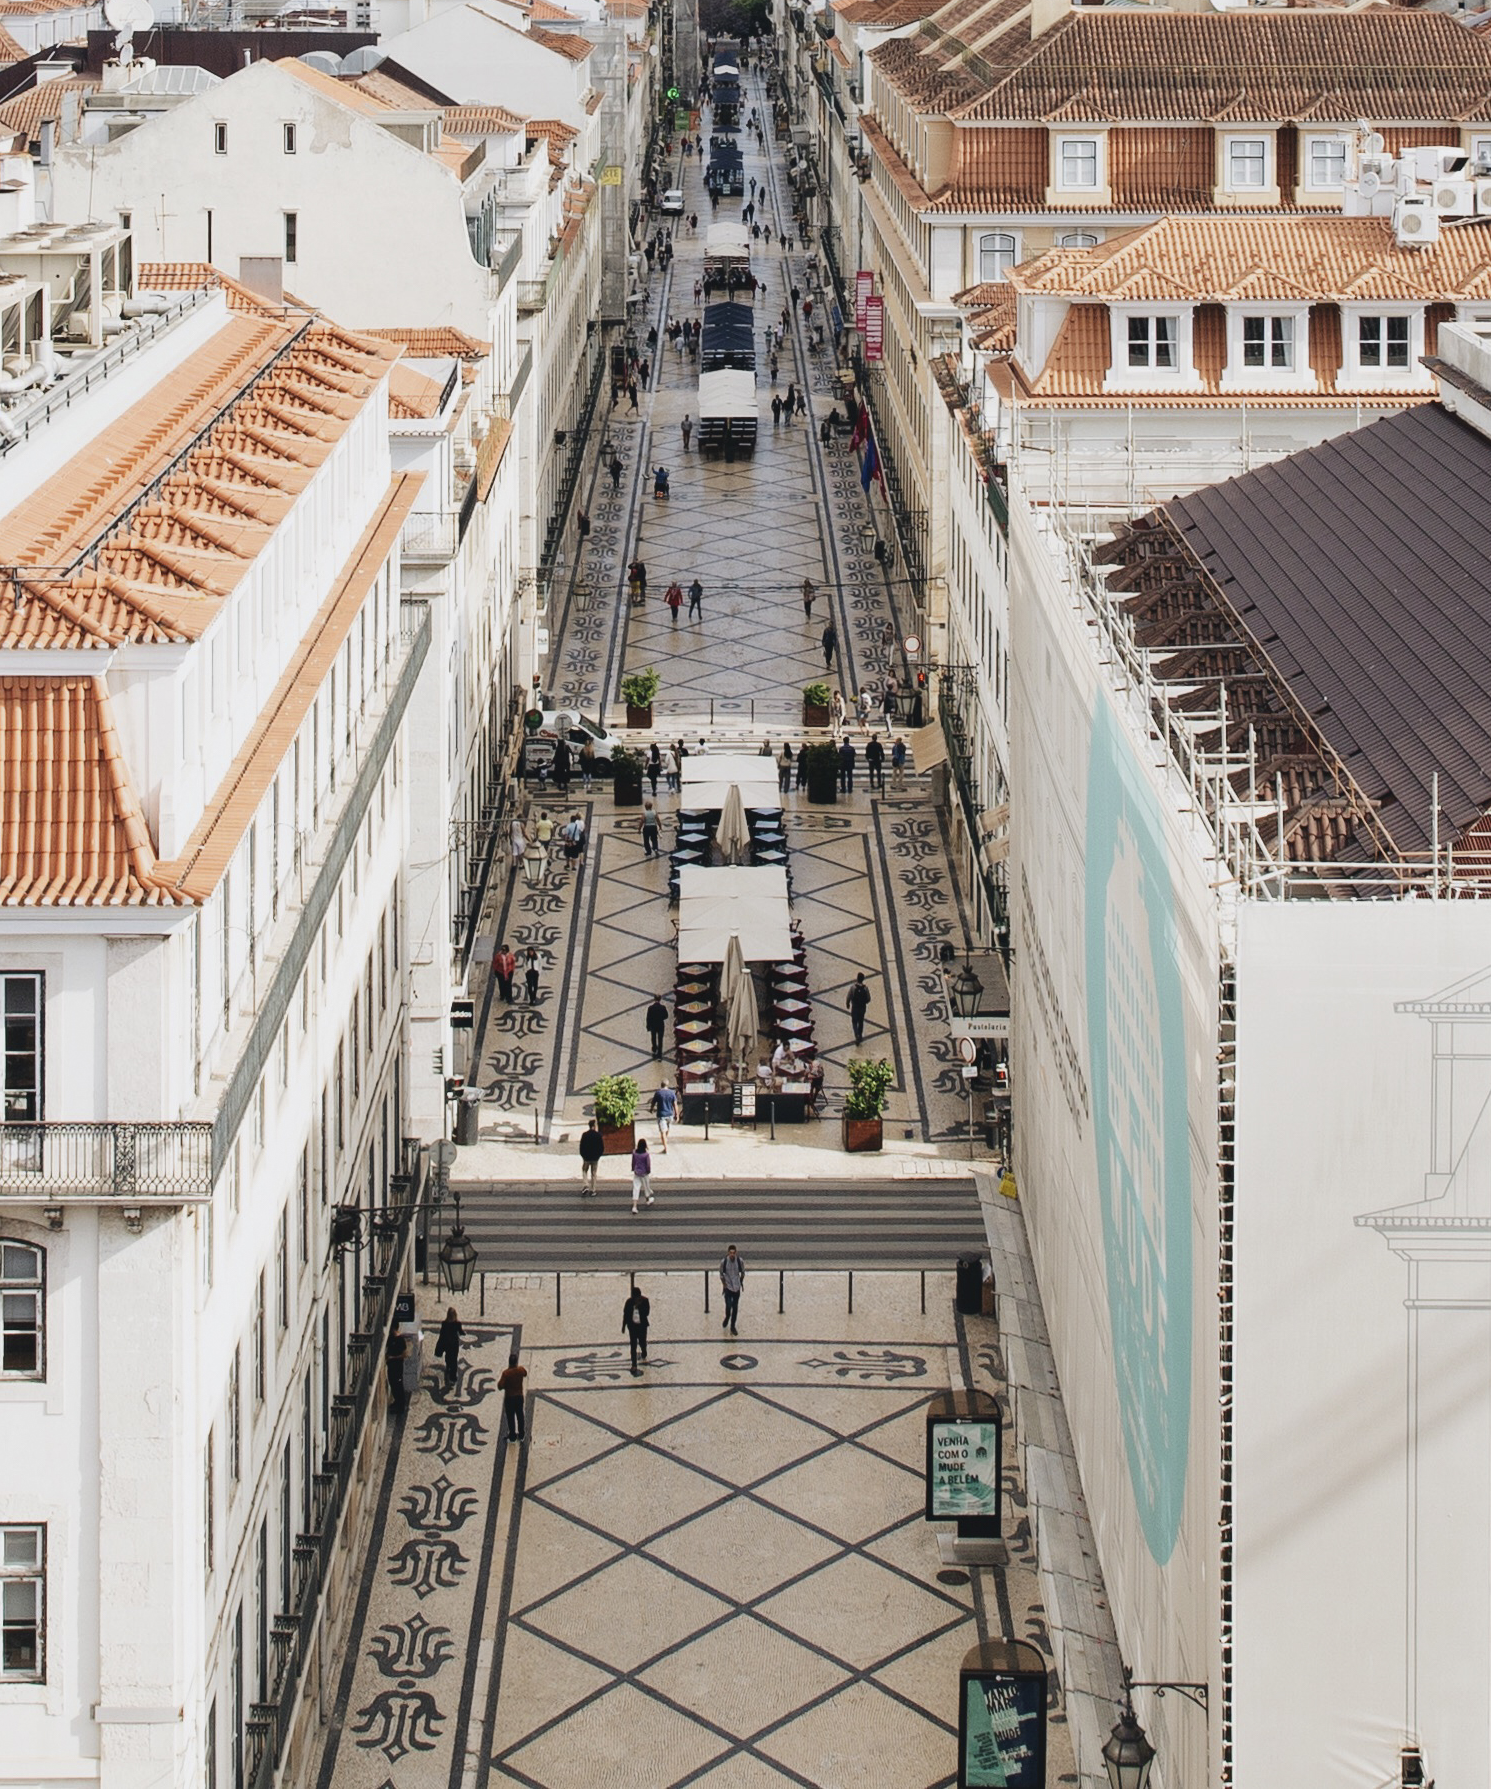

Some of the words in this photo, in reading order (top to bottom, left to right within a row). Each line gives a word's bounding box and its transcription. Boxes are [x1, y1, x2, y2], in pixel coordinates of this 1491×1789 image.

[968, 1022, 1007, 1030] Pastelaria
[1109, 1138, 1168, 1395] MUDE
[937, 1436, 969, 1446] VENHA
[938, 1450, 959, 1459] COM
[961, 1449, 968, 1458] O
[938, 1462, 965, 1472] MUDE
[939, 1476, 945, 1485] A
[948, 1473, 979, 1485] BELÉM
